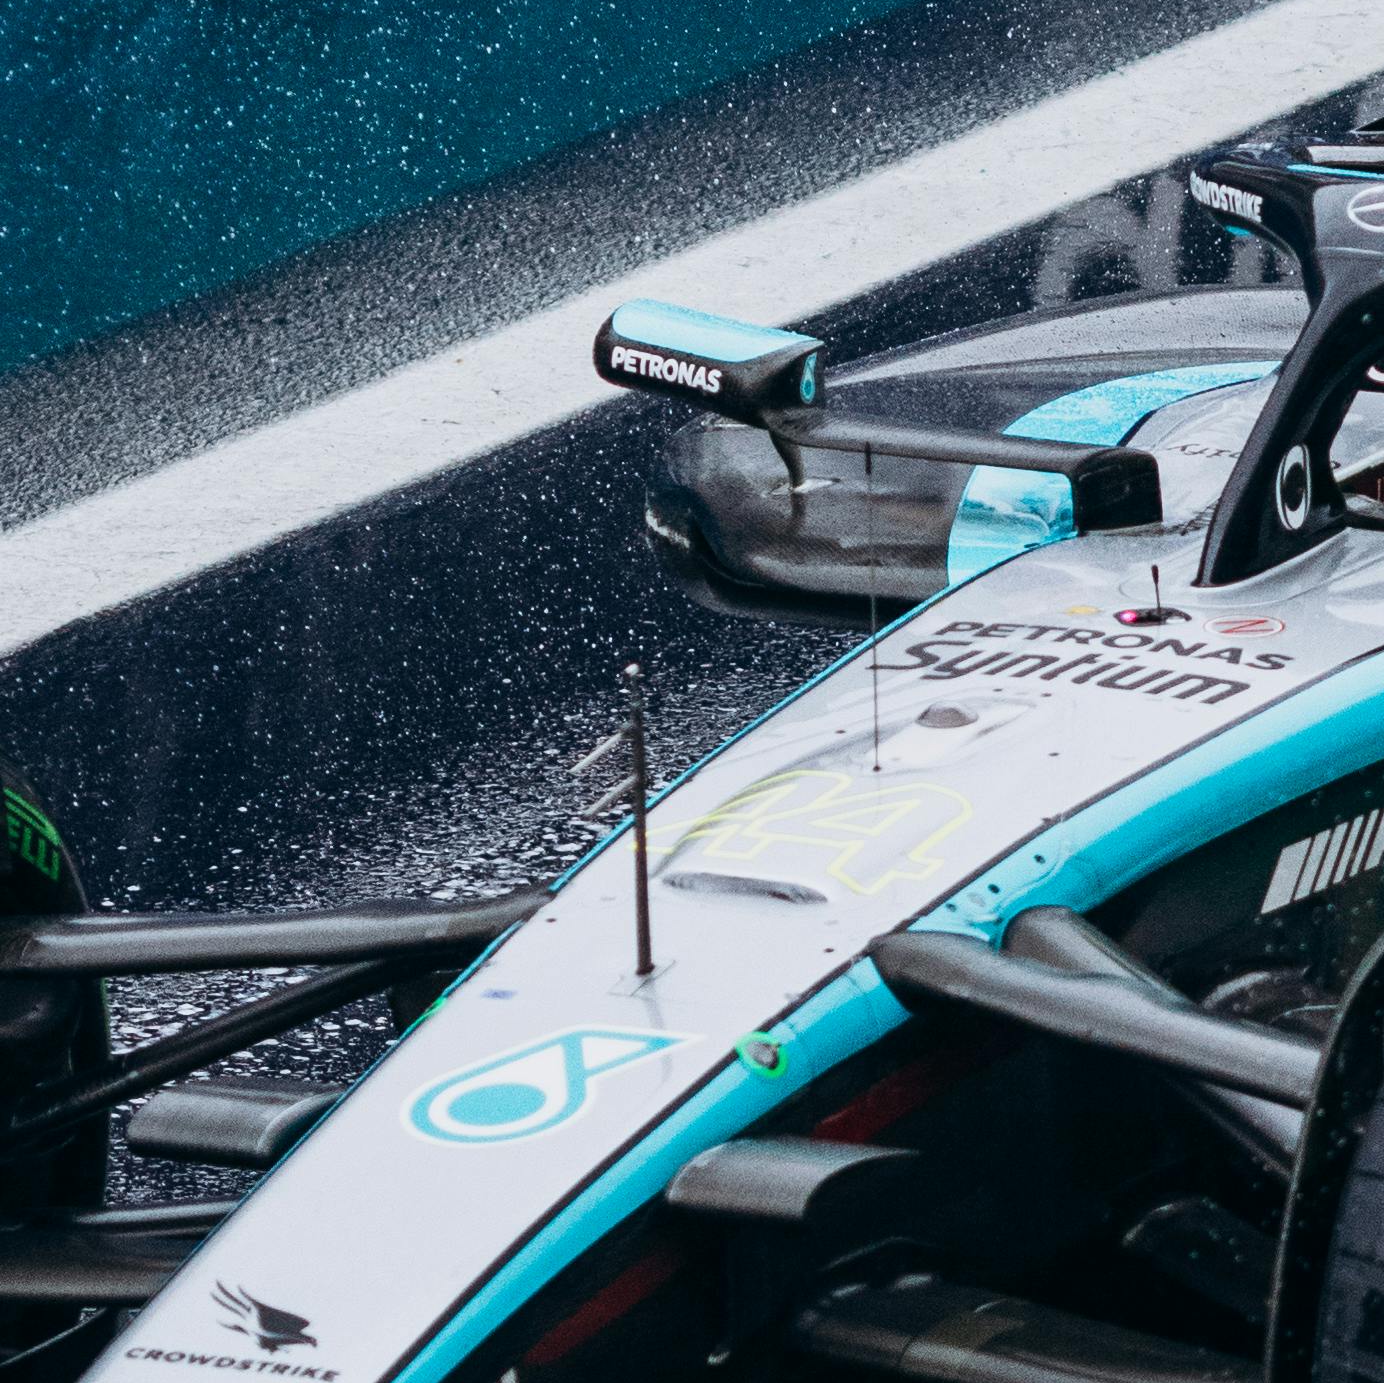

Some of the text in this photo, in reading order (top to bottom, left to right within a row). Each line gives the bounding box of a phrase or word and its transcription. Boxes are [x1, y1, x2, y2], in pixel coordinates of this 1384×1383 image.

[611, 345, 723, 394] PETRONAS
[933, 620, 1296, 672] PETRONAS
[864, 639, 1252, 706] Syntium
[124, 1346, 341, 1383] CROWDSTRIKE
